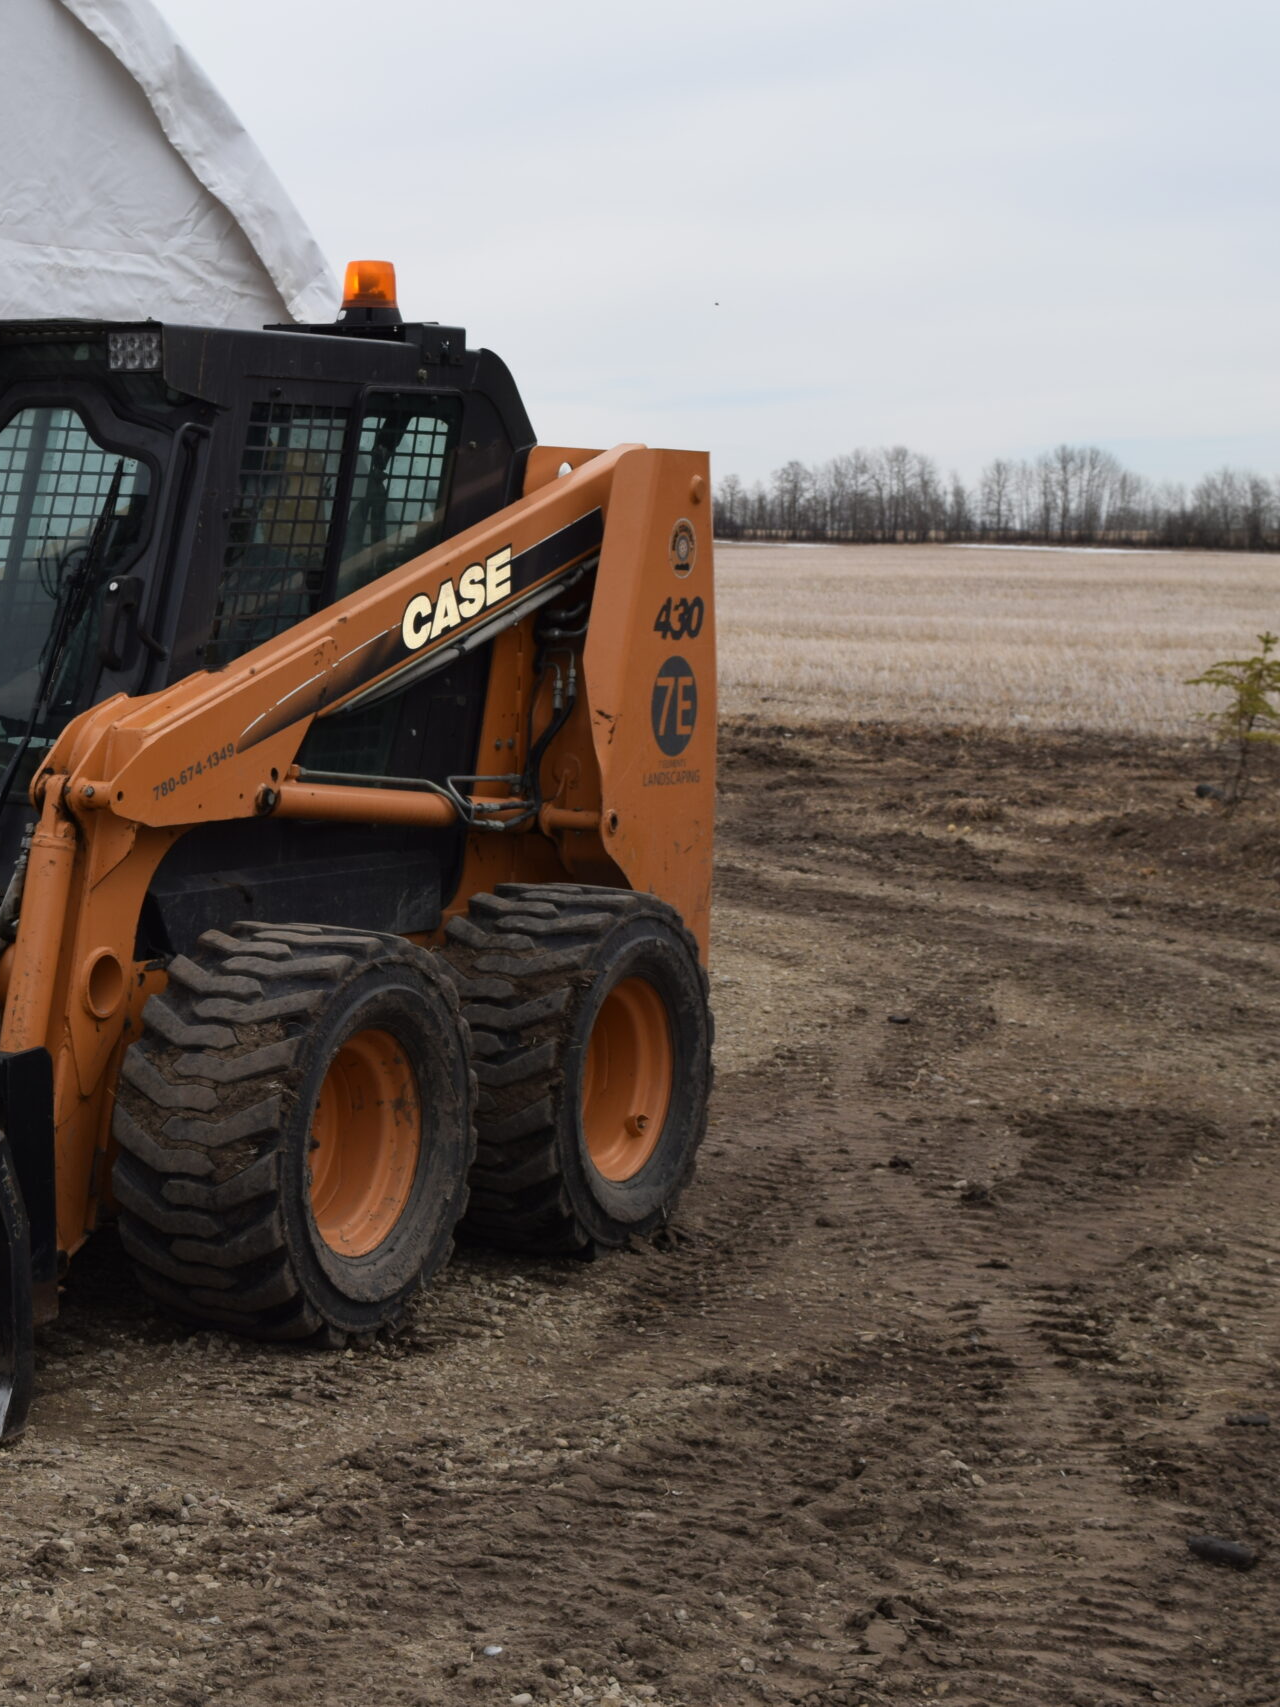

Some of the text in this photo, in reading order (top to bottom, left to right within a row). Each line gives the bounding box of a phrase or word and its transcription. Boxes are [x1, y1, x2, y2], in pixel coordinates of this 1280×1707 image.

[401, 544, 512, 650] CASE
[653, 596, 705, 641] 430
[656, 676, 694, 736] 7E
[152, 743, 235, 801] 780-674-1349
[641, 769, 701, 788] LANDSCAPING
